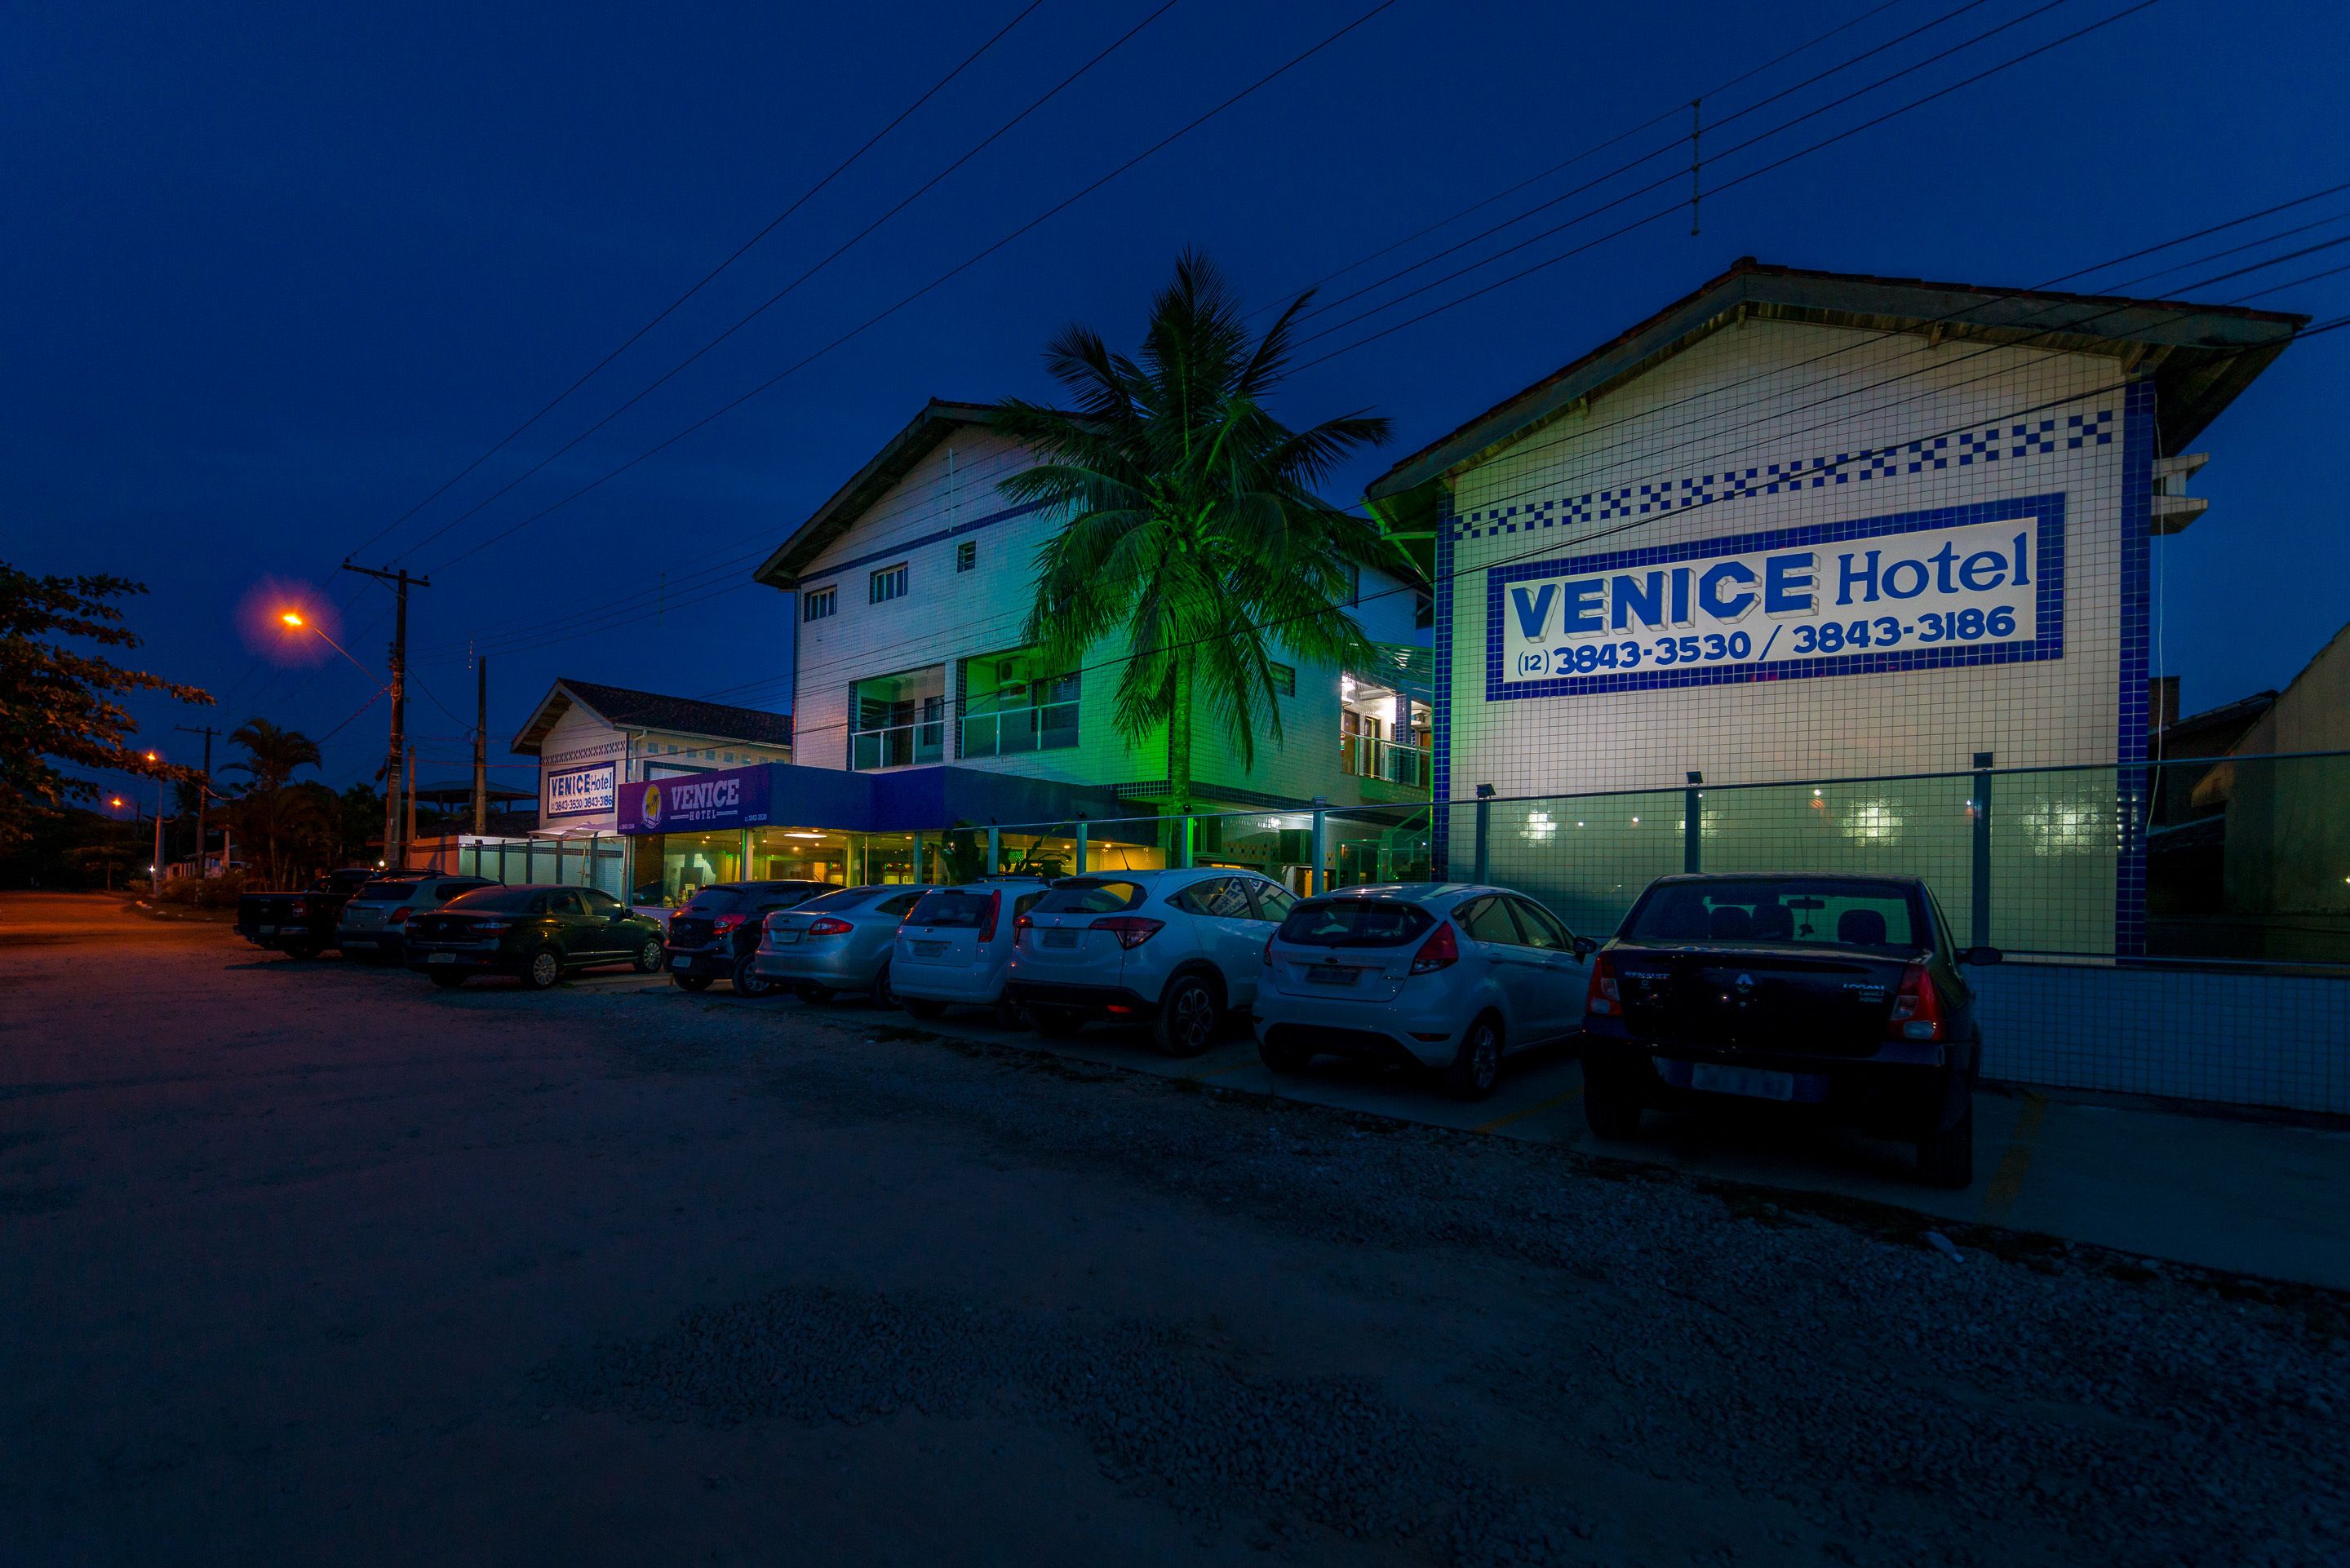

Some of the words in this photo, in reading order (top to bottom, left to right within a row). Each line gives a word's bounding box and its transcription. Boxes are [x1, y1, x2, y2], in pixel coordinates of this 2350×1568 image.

[1511, 552, 1820, 644] VENICE
[1836, 532, 2030, 605] Hotel
[1518, 649, 1550, 676] (12)
[1553, 631, 1752, 675] 3843-3530
[1793, 606, 2016, 654] 3843-3186
[552, 773, 590, 798] VENICE
[590, 772, 612, 791] Hotel
[671, 778, 739, 810] VENICE
[689, 810, 716, 821] HOTEL
